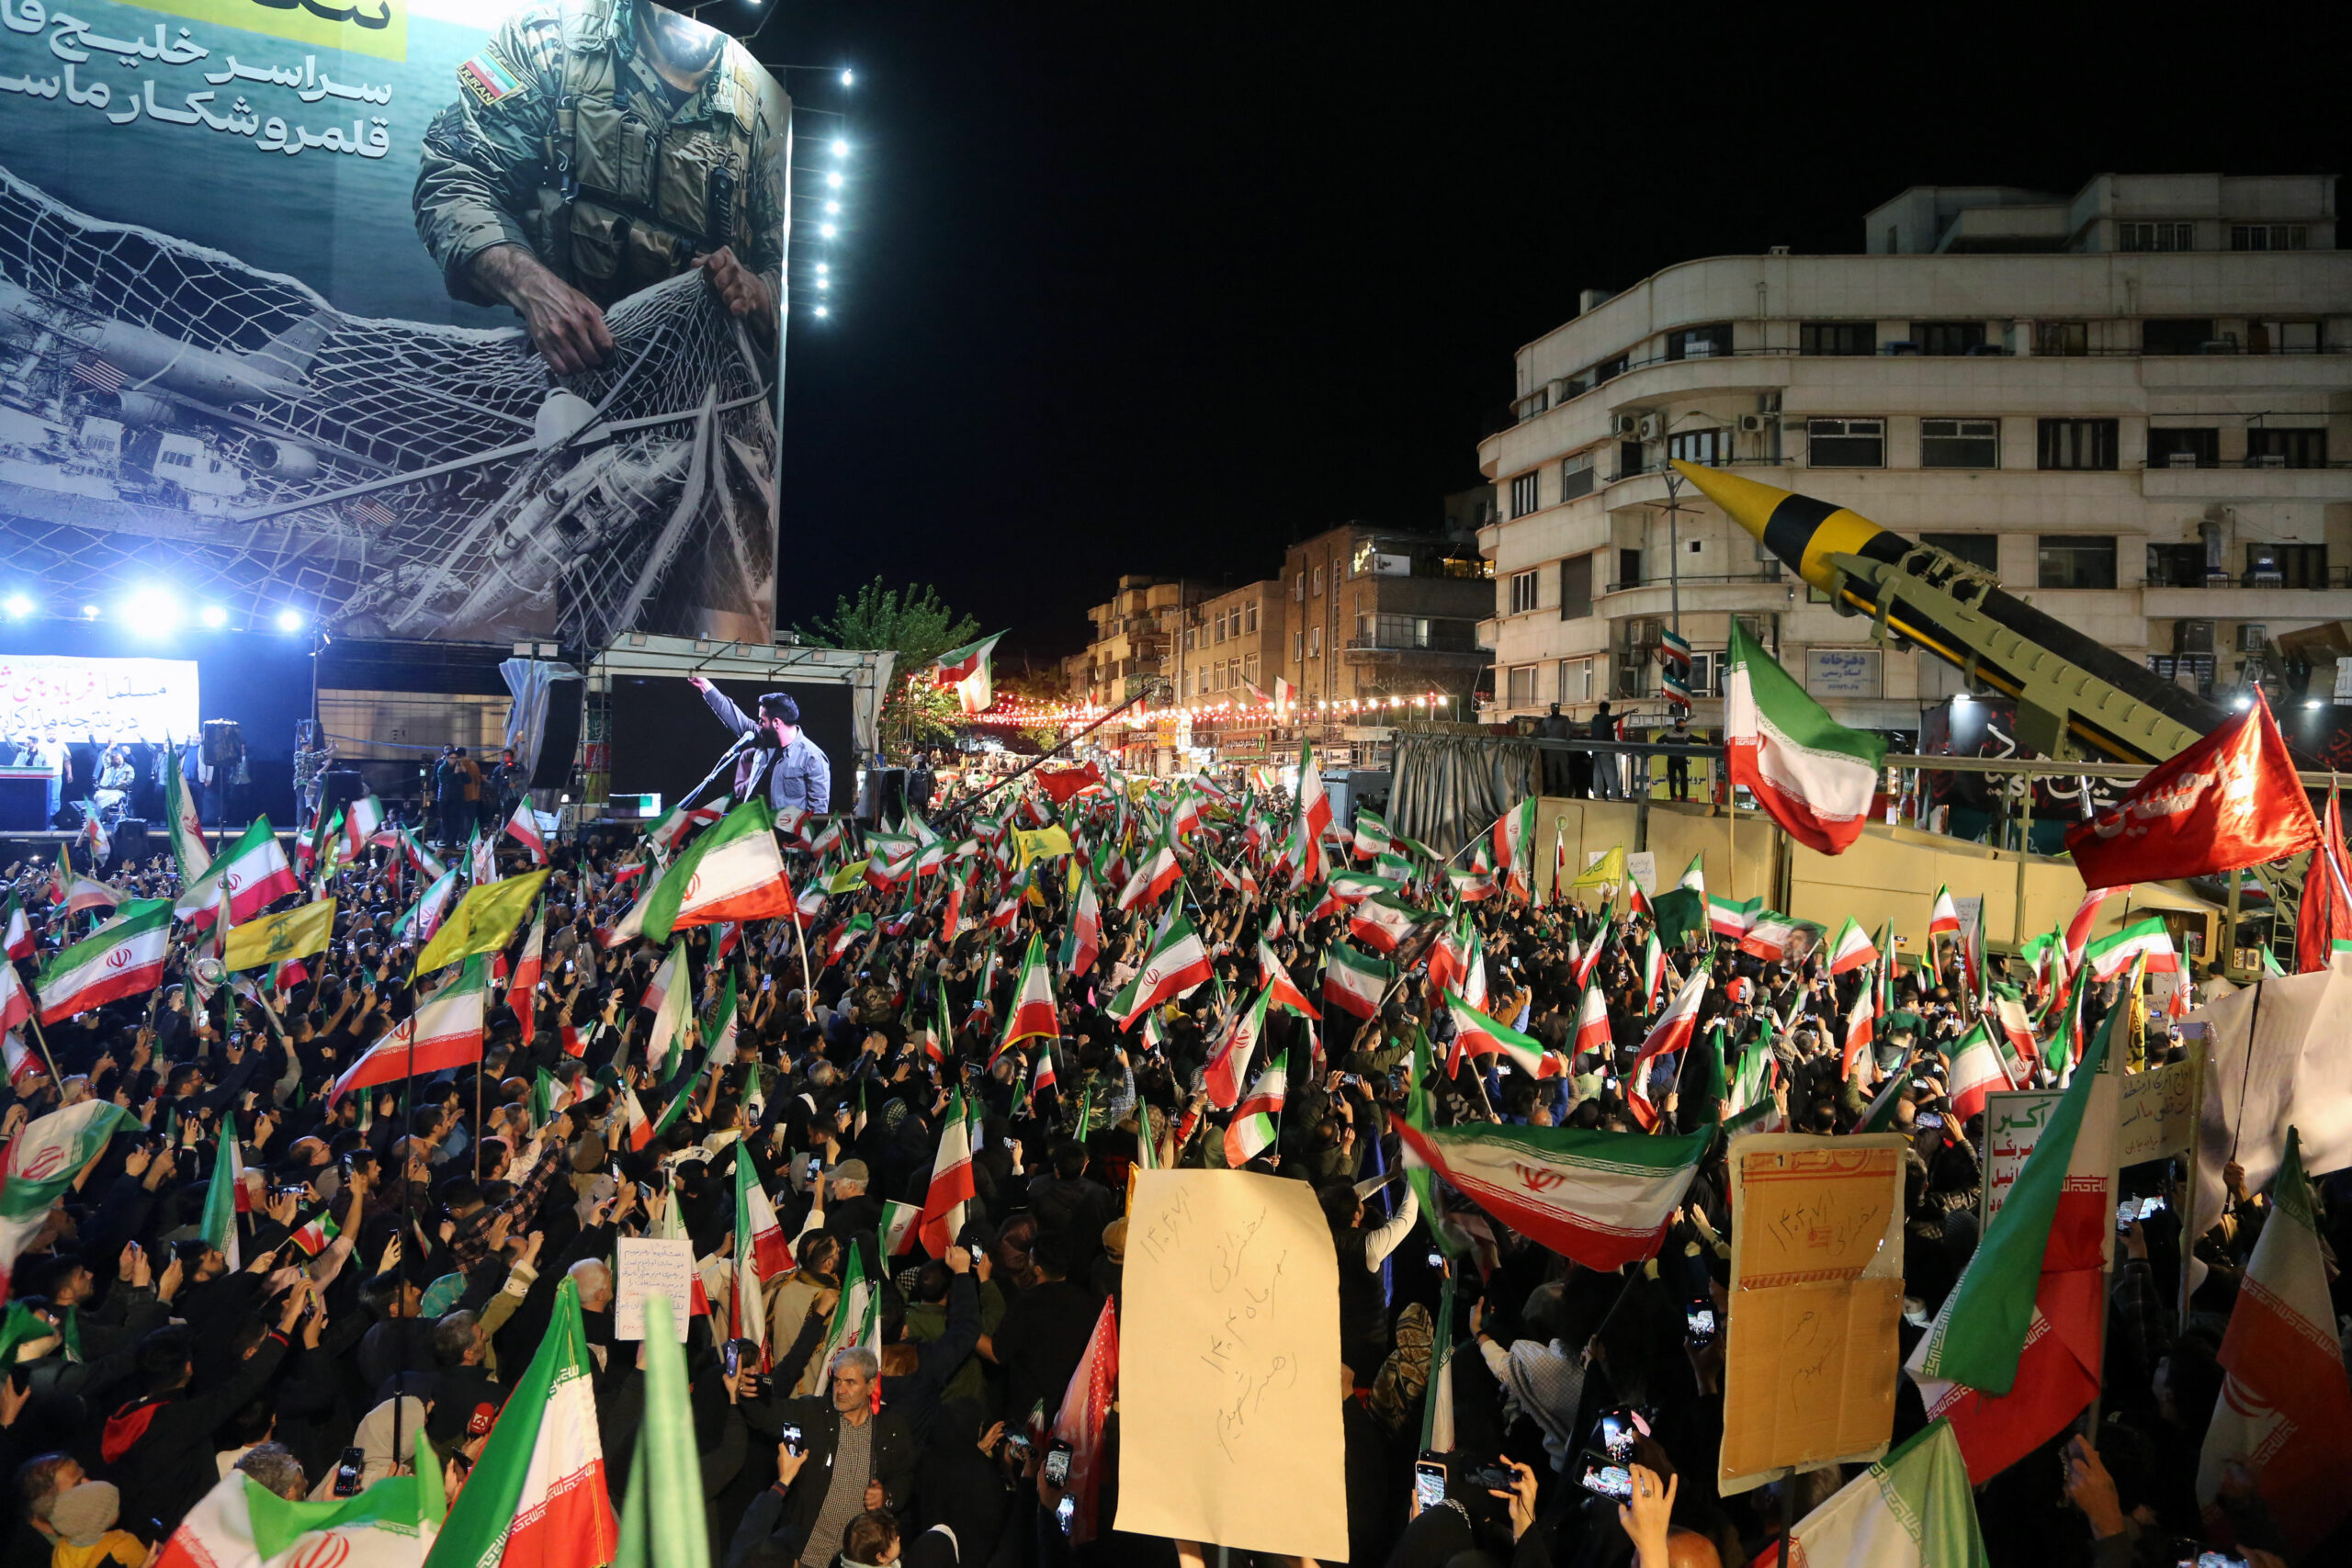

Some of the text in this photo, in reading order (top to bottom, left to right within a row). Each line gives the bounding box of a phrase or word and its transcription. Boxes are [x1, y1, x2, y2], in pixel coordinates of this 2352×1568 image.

[50, 24, 210, 68] خلیج
[204, 54, 392, 105] سراسر
[458, 65, 495, 102] I.R.IRAN
[107, 79, 259, 136] شکار
[255, 115, 390, 158] قلمرو
[115, 716, 140, 733] در
[2094, 772, 2214, 839] حسین
[2139, 1100, 2154, 1118] ما
